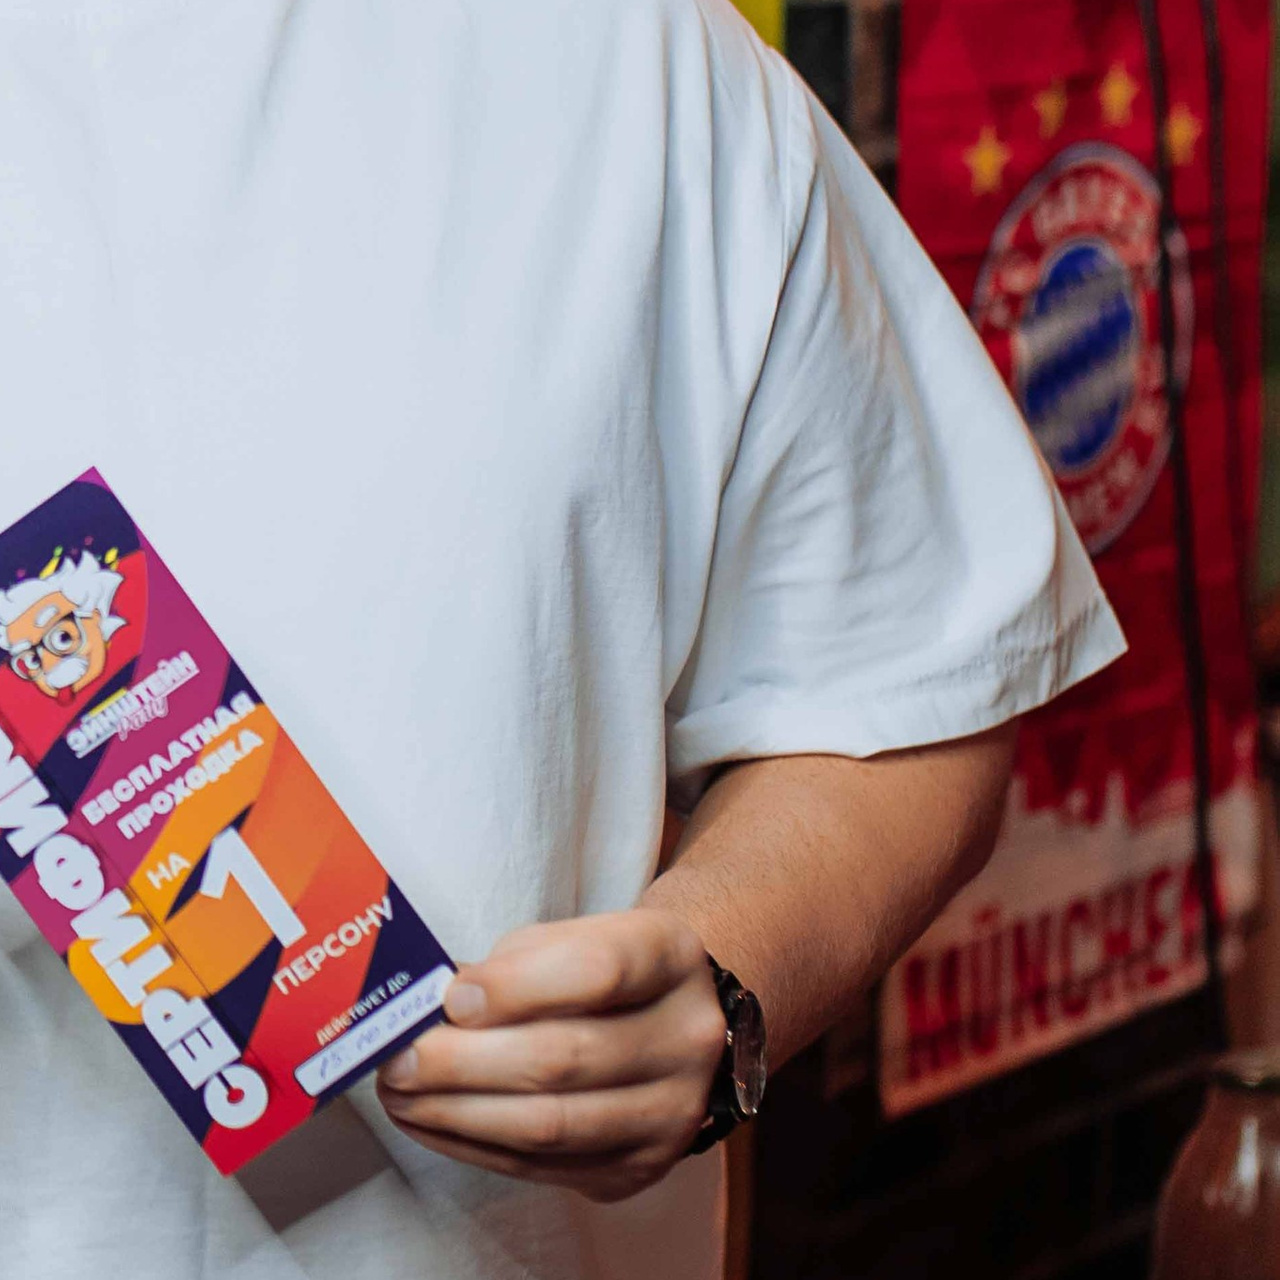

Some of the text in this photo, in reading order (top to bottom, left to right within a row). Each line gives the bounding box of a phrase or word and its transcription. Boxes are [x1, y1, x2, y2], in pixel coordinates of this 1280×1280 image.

[66, 650, 198, 754] ЭЙНШТЕЙН
[81, 692, 256, 825] БЕСПЛАТНАЯ
[117, 729, 263, 839] ПРОХОДКА
[146, 852, 190, 889] НА
[199, 826, 307, 948] 1
[273, 896, 394, 995] ПЕРСОНУ
[316, 985, 388, 1046] ДЕЙСТВУЕТ
